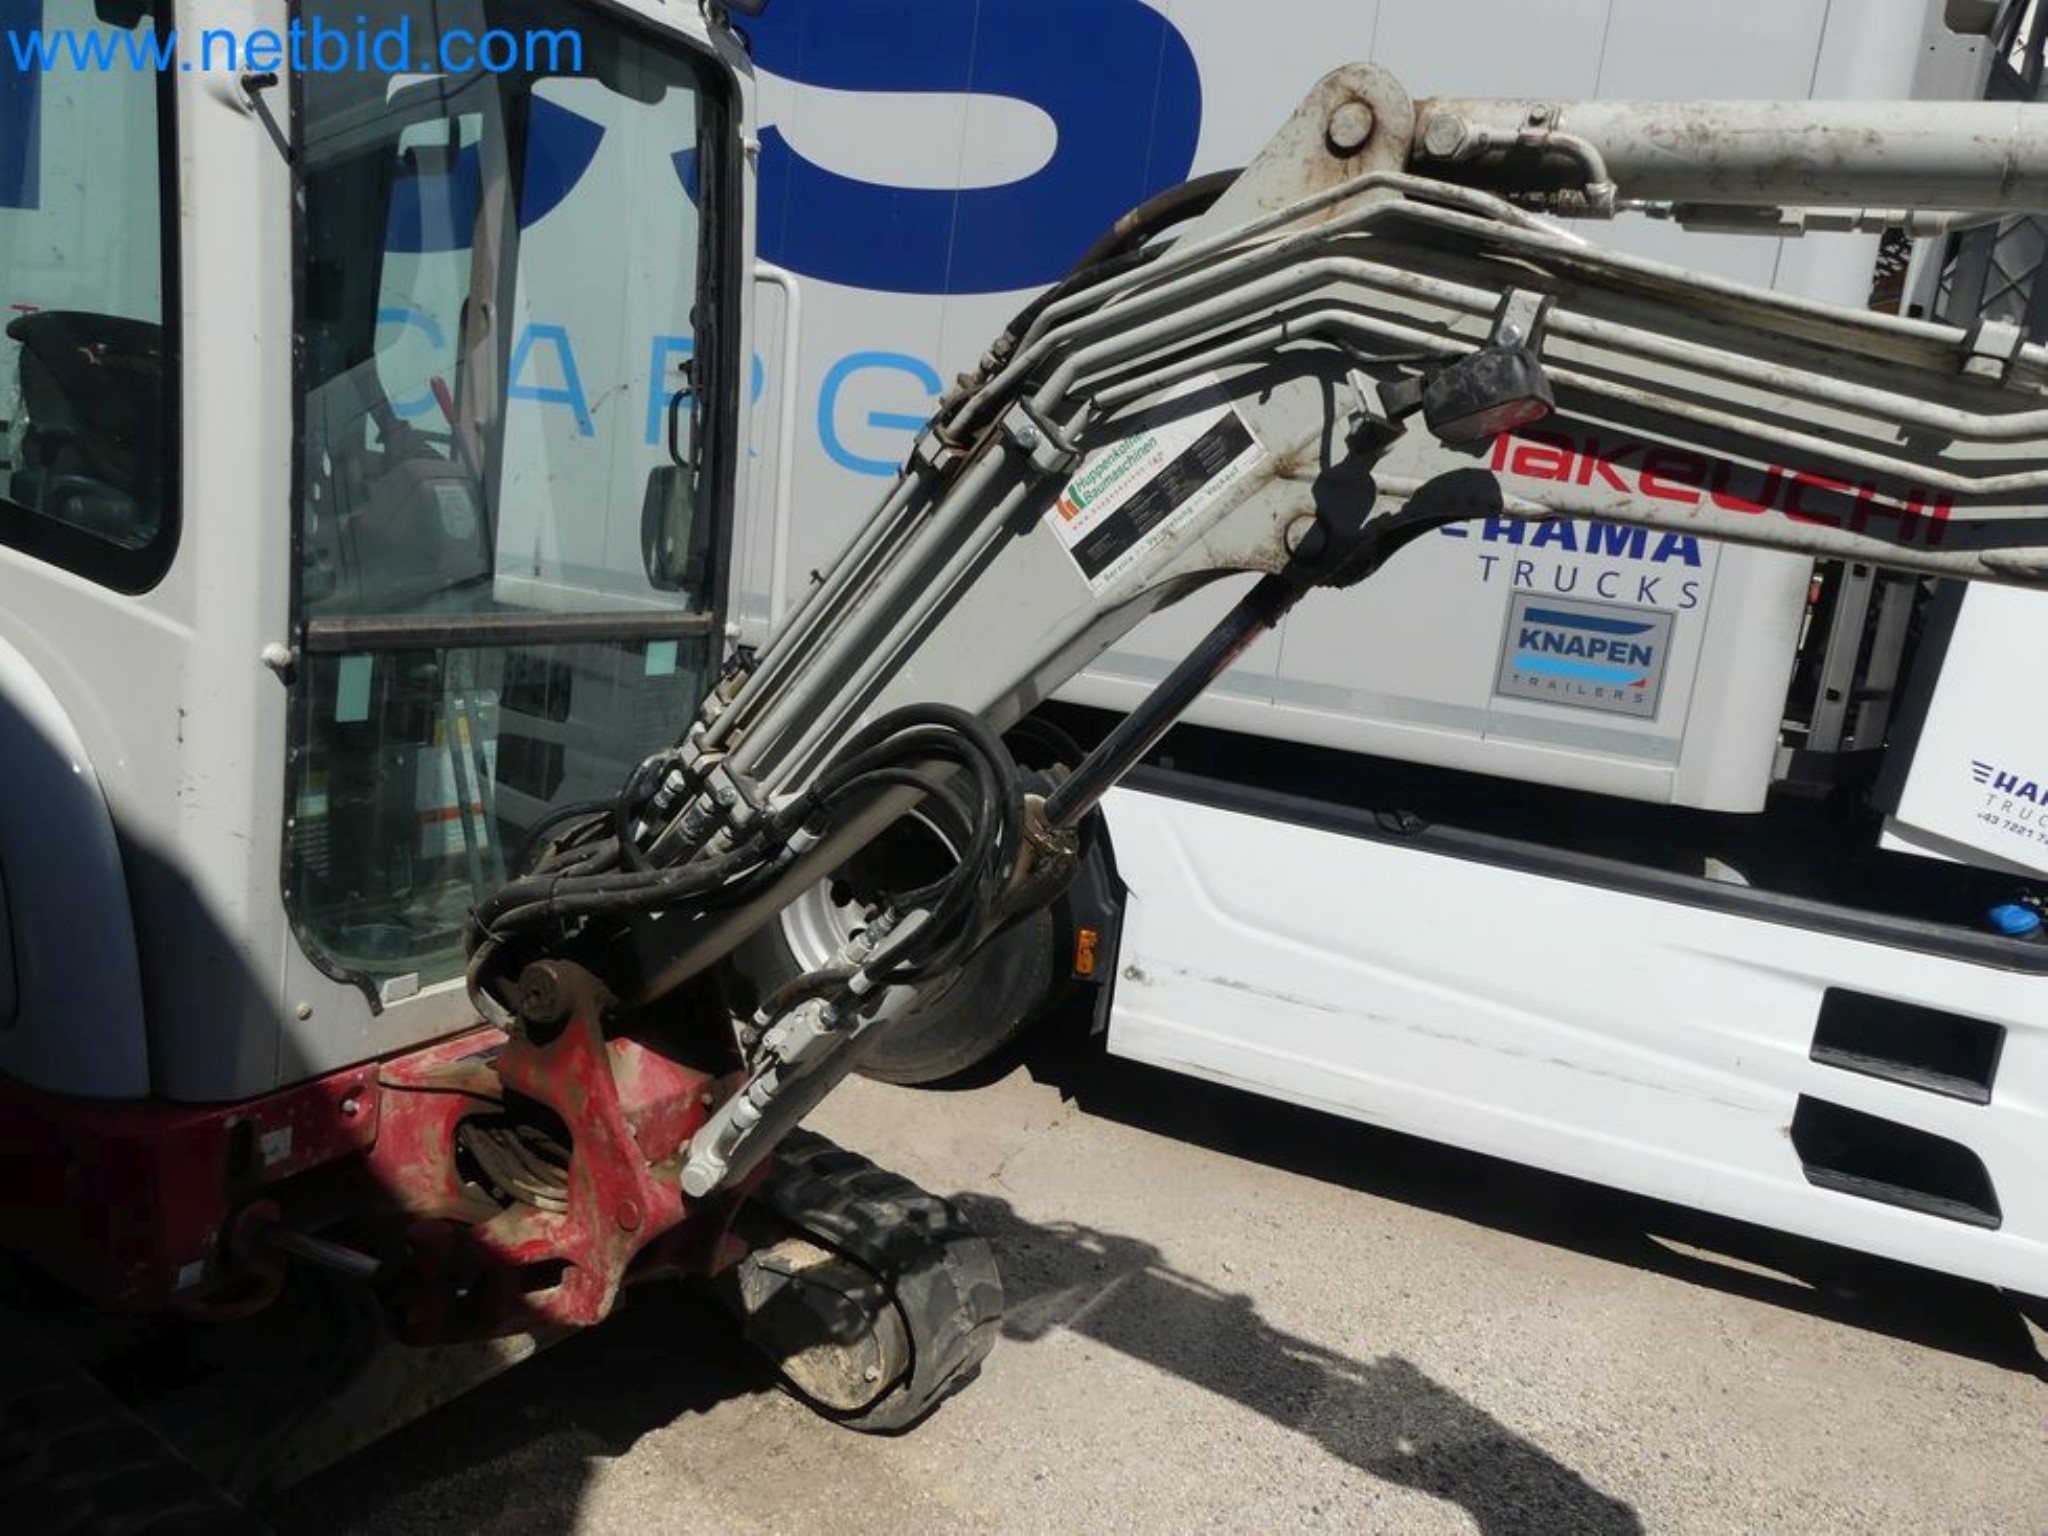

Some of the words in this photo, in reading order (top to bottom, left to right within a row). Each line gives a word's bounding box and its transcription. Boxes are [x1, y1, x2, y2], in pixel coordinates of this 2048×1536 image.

[374, 307, 943, 476] CARG
[1083, 437, 1157, 504] Baumaschinen
[1482, 518, 1702, 567] HAMA
[1479, 555, 1699, 609] TRUCKS
[1518, 628, 1653, 667] KNAPEN
[1512, 674, 1644, 703] TRAILERS
